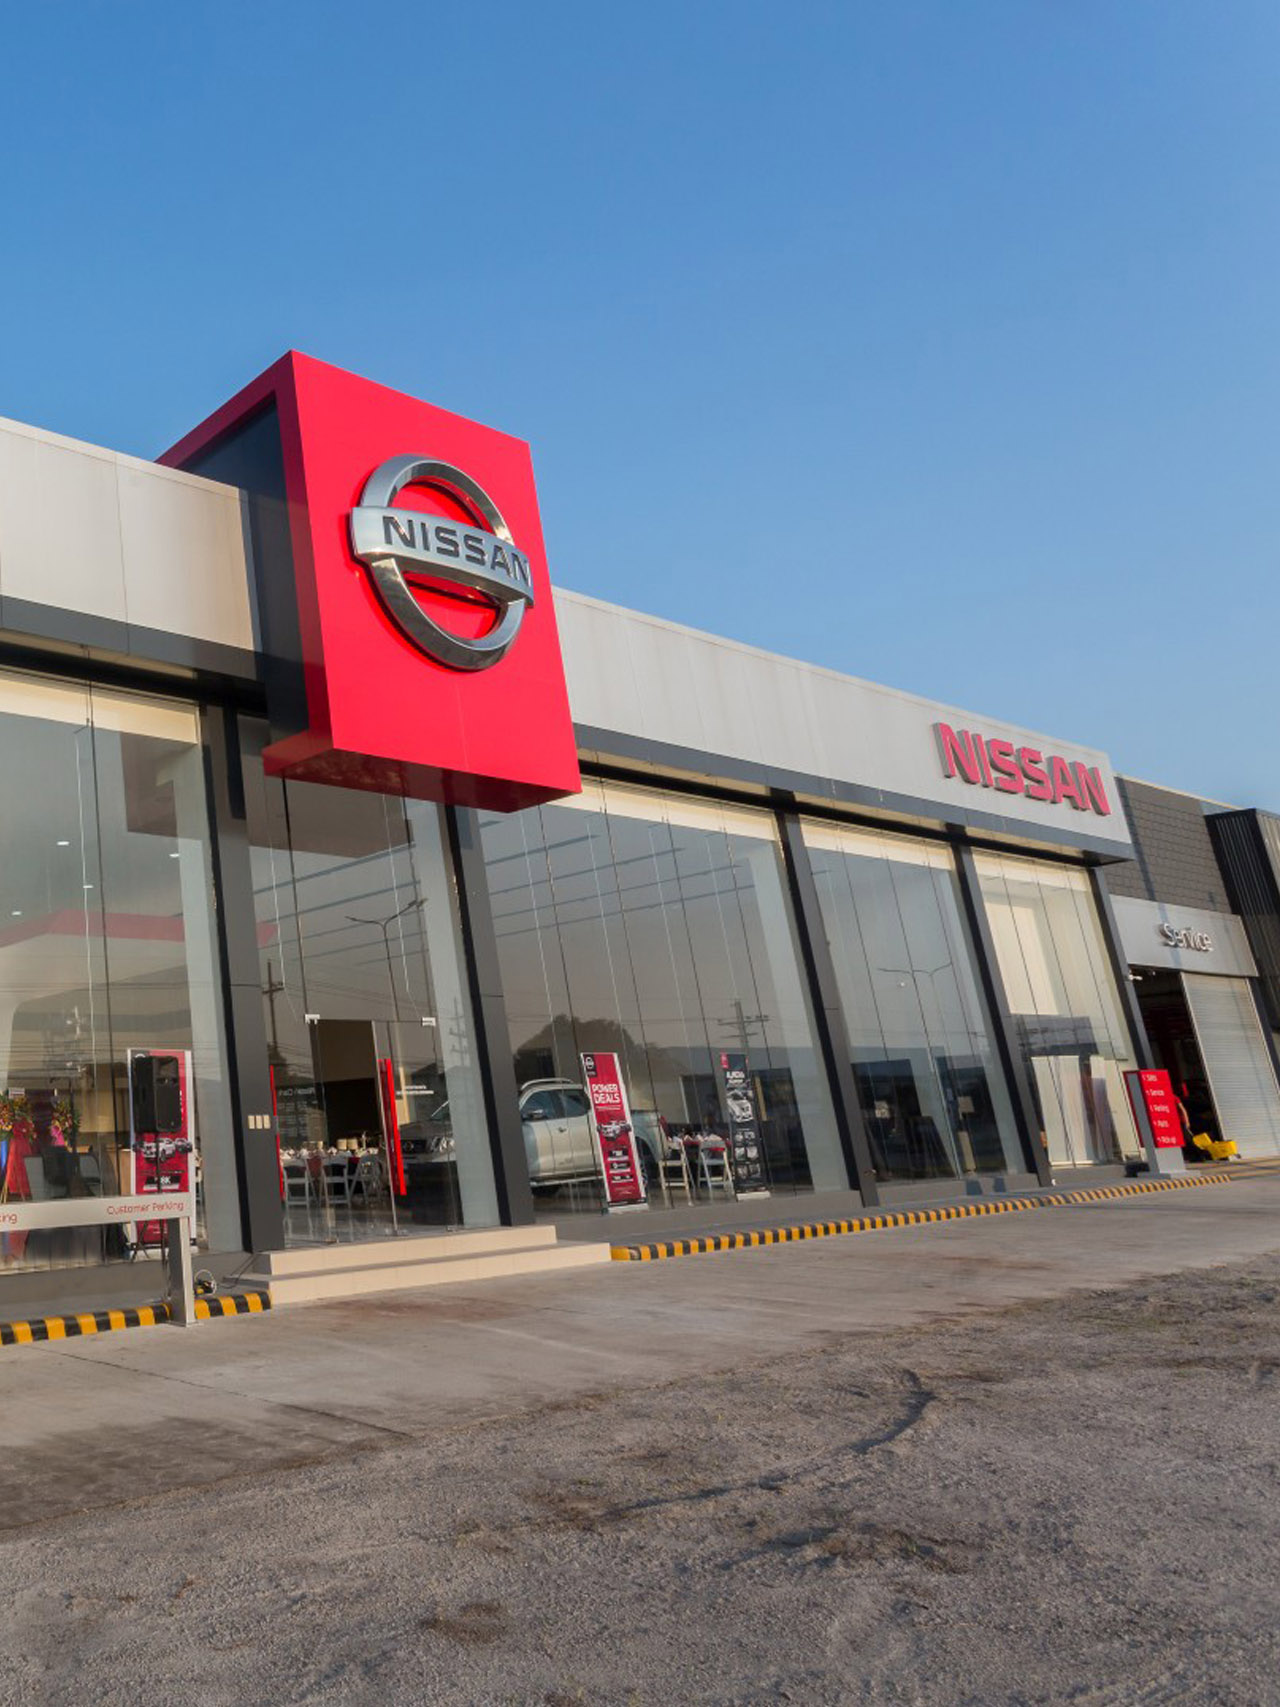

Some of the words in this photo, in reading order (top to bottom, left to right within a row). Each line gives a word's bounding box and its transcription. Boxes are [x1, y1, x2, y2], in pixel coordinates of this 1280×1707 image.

[382, 514, 532, 588] NISSAN
[932, 722, 1111, 816] NISSAN
[1159, 923, 1215, 952] Service
[592, 1083, 619, 1093] POWER
[593, 1093, 621, 1104] DEALS
[107, 1203, 151, 1215] Customer
[152, 1201, 185, 1212] Parking
